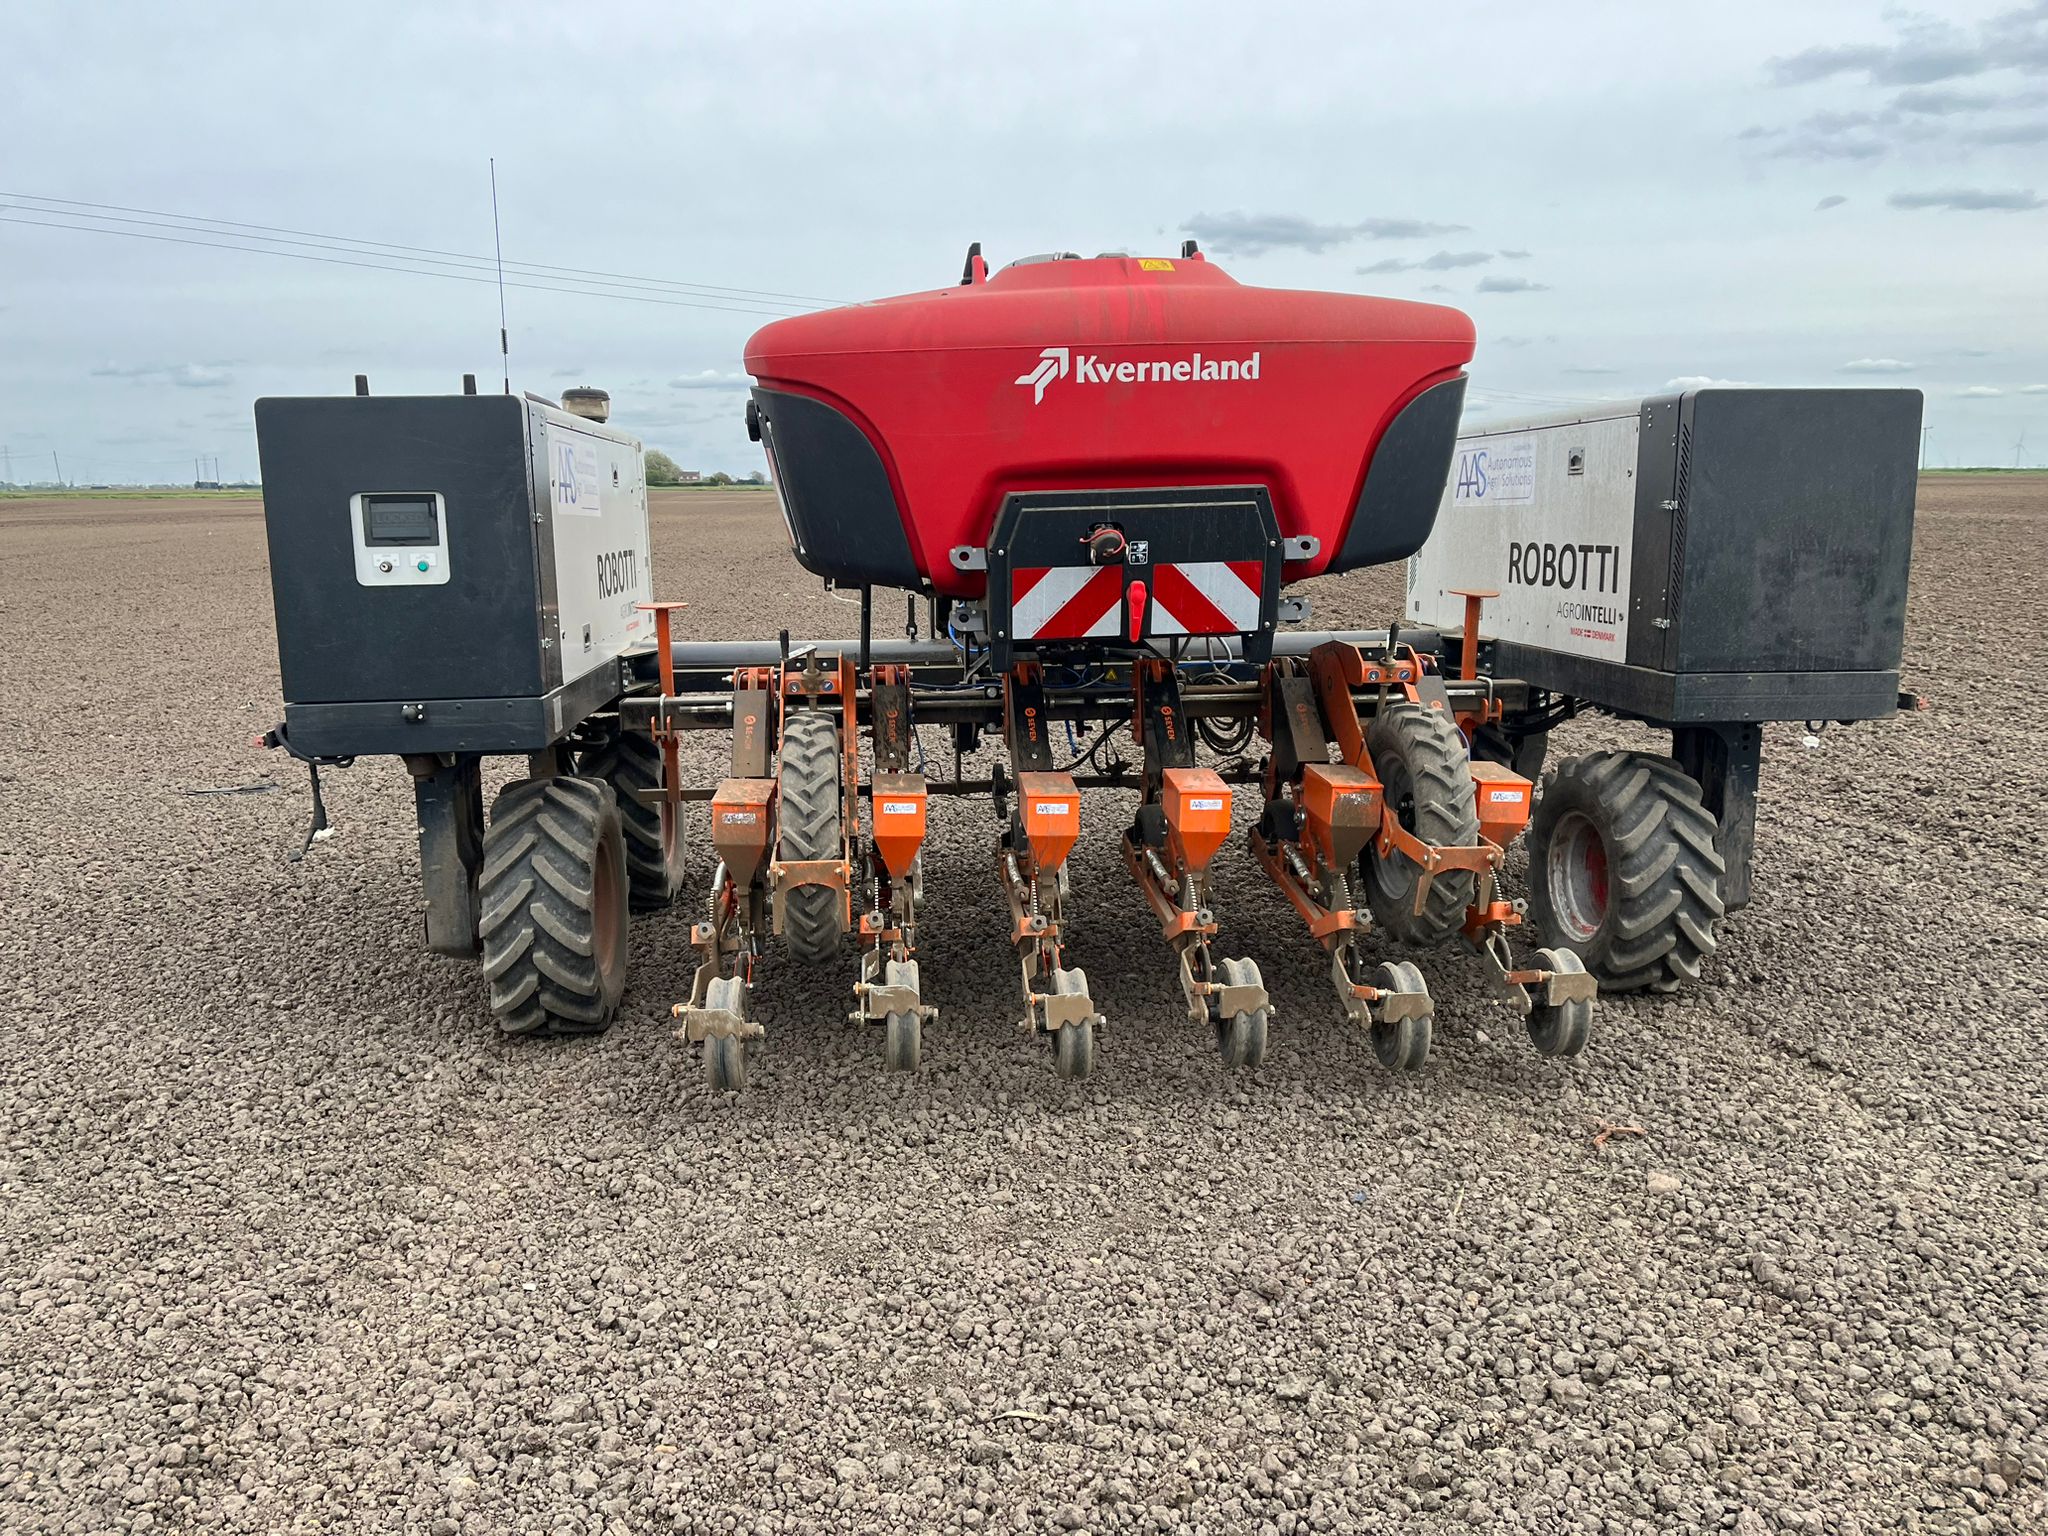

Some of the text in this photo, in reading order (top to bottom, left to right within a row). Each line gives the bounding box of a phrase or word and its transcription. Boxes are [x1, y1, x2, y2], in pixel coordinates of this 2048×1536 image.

[1076, 352, 1260, 384] Kverneland
[559, 446, 577, 504] AAS
[1456, 451, 1488, 498] AAS
[1488, 456, 1532, 471] Autonomous
[1487, 473, 1532, 491] Agri Solutions
[597, 549, 637, 600] ROBOTTI
[1508, 542, 1620, 594] ROBOTTI
[1556, 602, 1617, 625] AGROINTELLI
[1570, 627, 1616, 642] MADE DENMARK
[1028, 718, 1038, 742] SEVEN
[1165, 716, 1176, 741] SEVEN
